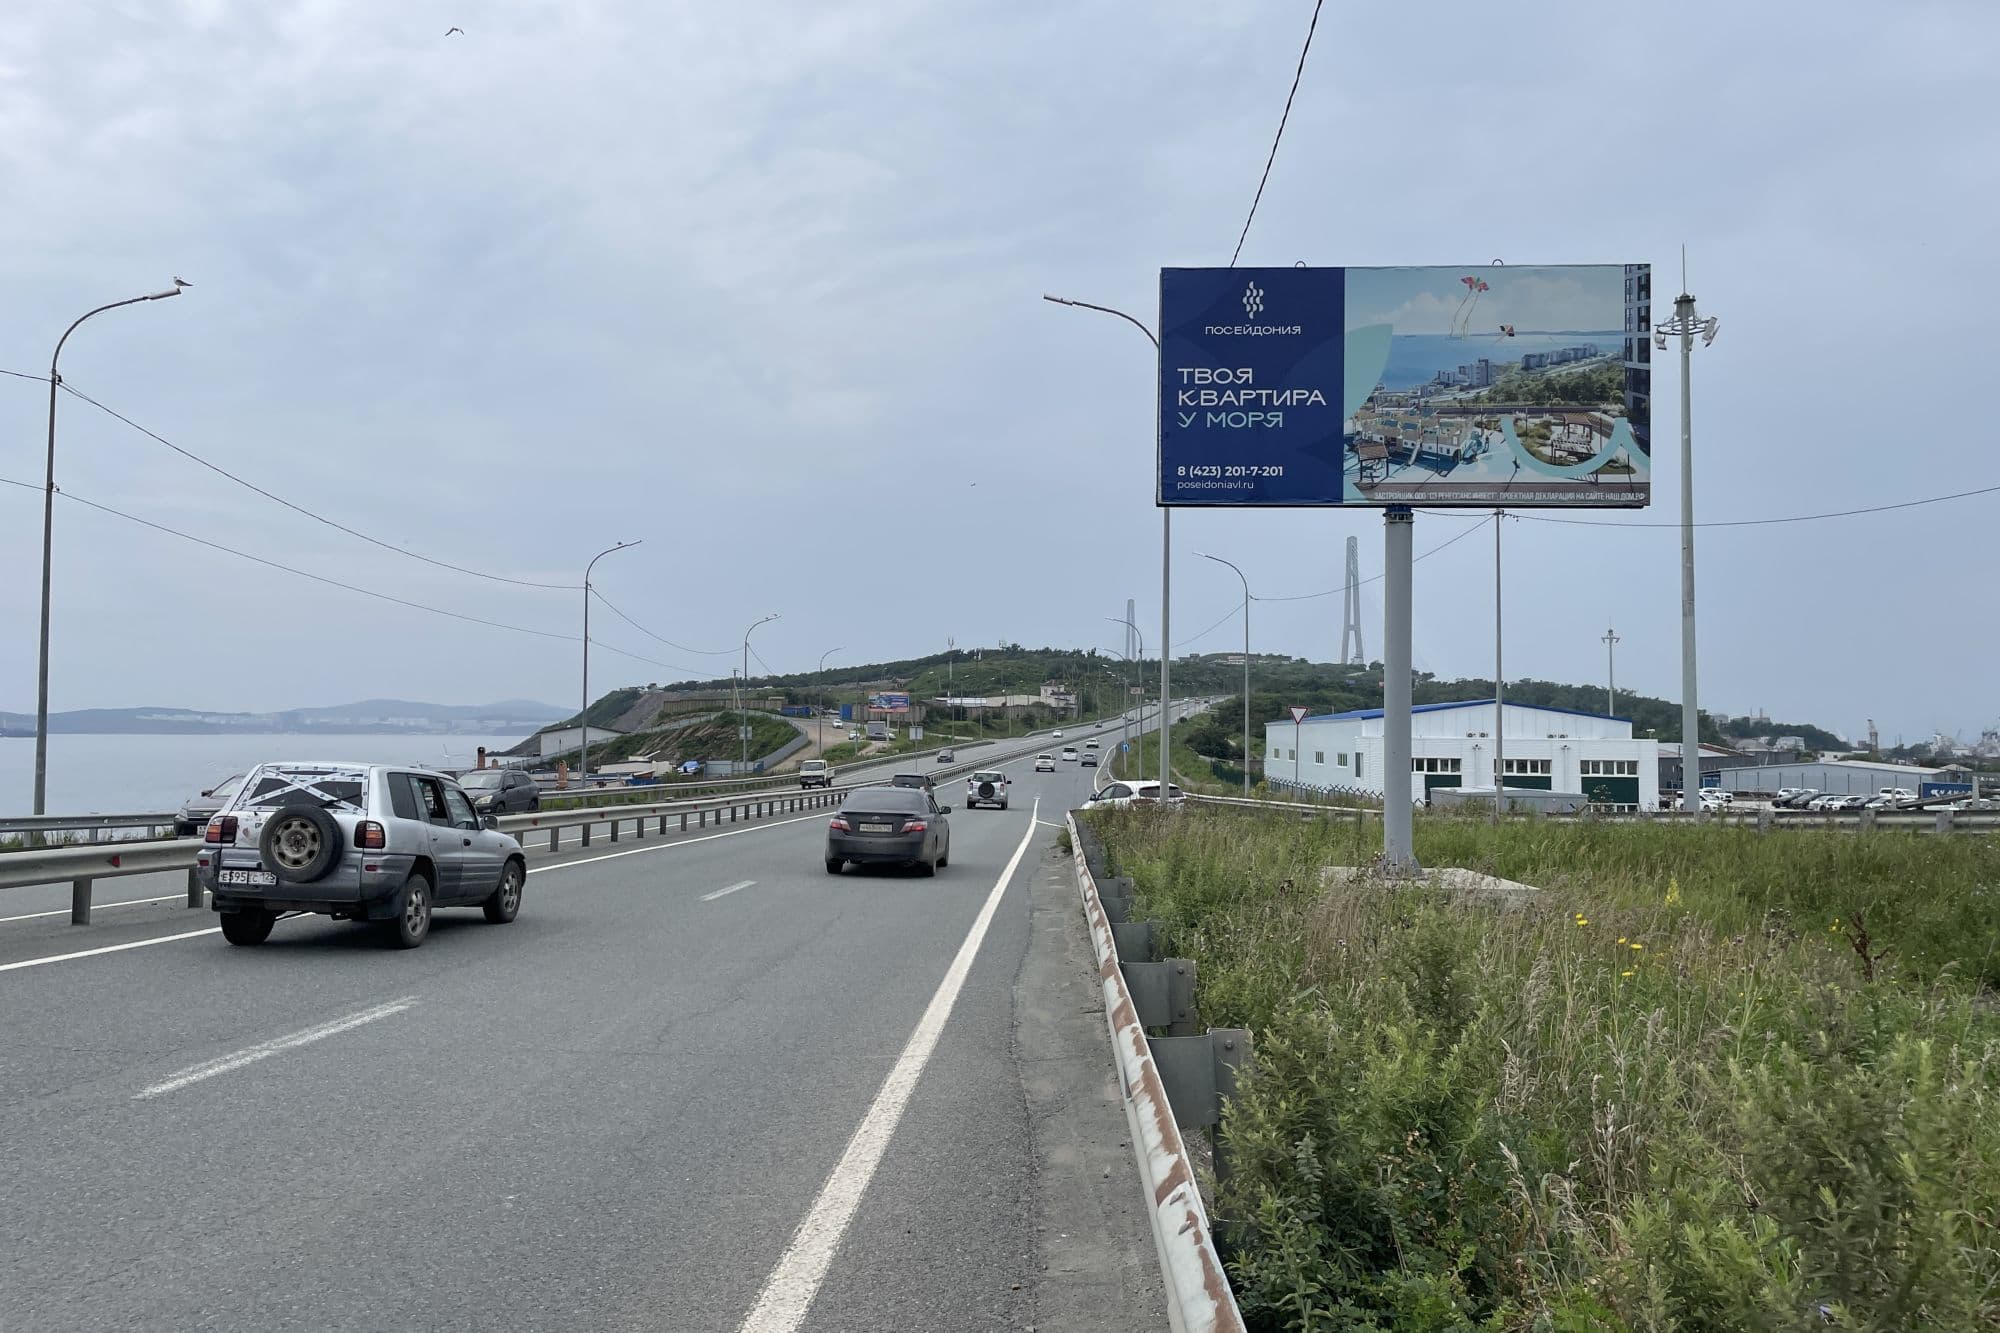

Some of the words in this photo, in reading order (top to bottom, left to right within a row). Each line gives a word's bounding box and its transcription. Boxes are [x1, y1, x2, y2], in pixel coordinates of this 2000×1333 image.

[1205, 324, 1301, 336] ПОСЕЙДОНИЯ
[1177, 368, 1253, 385] ТВОЯ
[1178, 389, 1327, 406] КВАРТИРА
[1177, 412, 1197, 428] У
[1207, 412, 1283, 428] МОРЯ
[1177, 466, 1186, 476] 8
[1190, 465, 1221, 478] (423)
[1225, 466, 1283, 476] 201-7-201
[1177, 480, 1254, 491] poseidoniavl.ru
[1500, 491, 1534, 500] ПРОЕКТНАЯ
[1534, 491, 1575, 500] ДЕКЛАРАЦИЯ
[1576, 491, 1584, 500] НА
[1585, 490, 1605, 500] САЙТЕ
